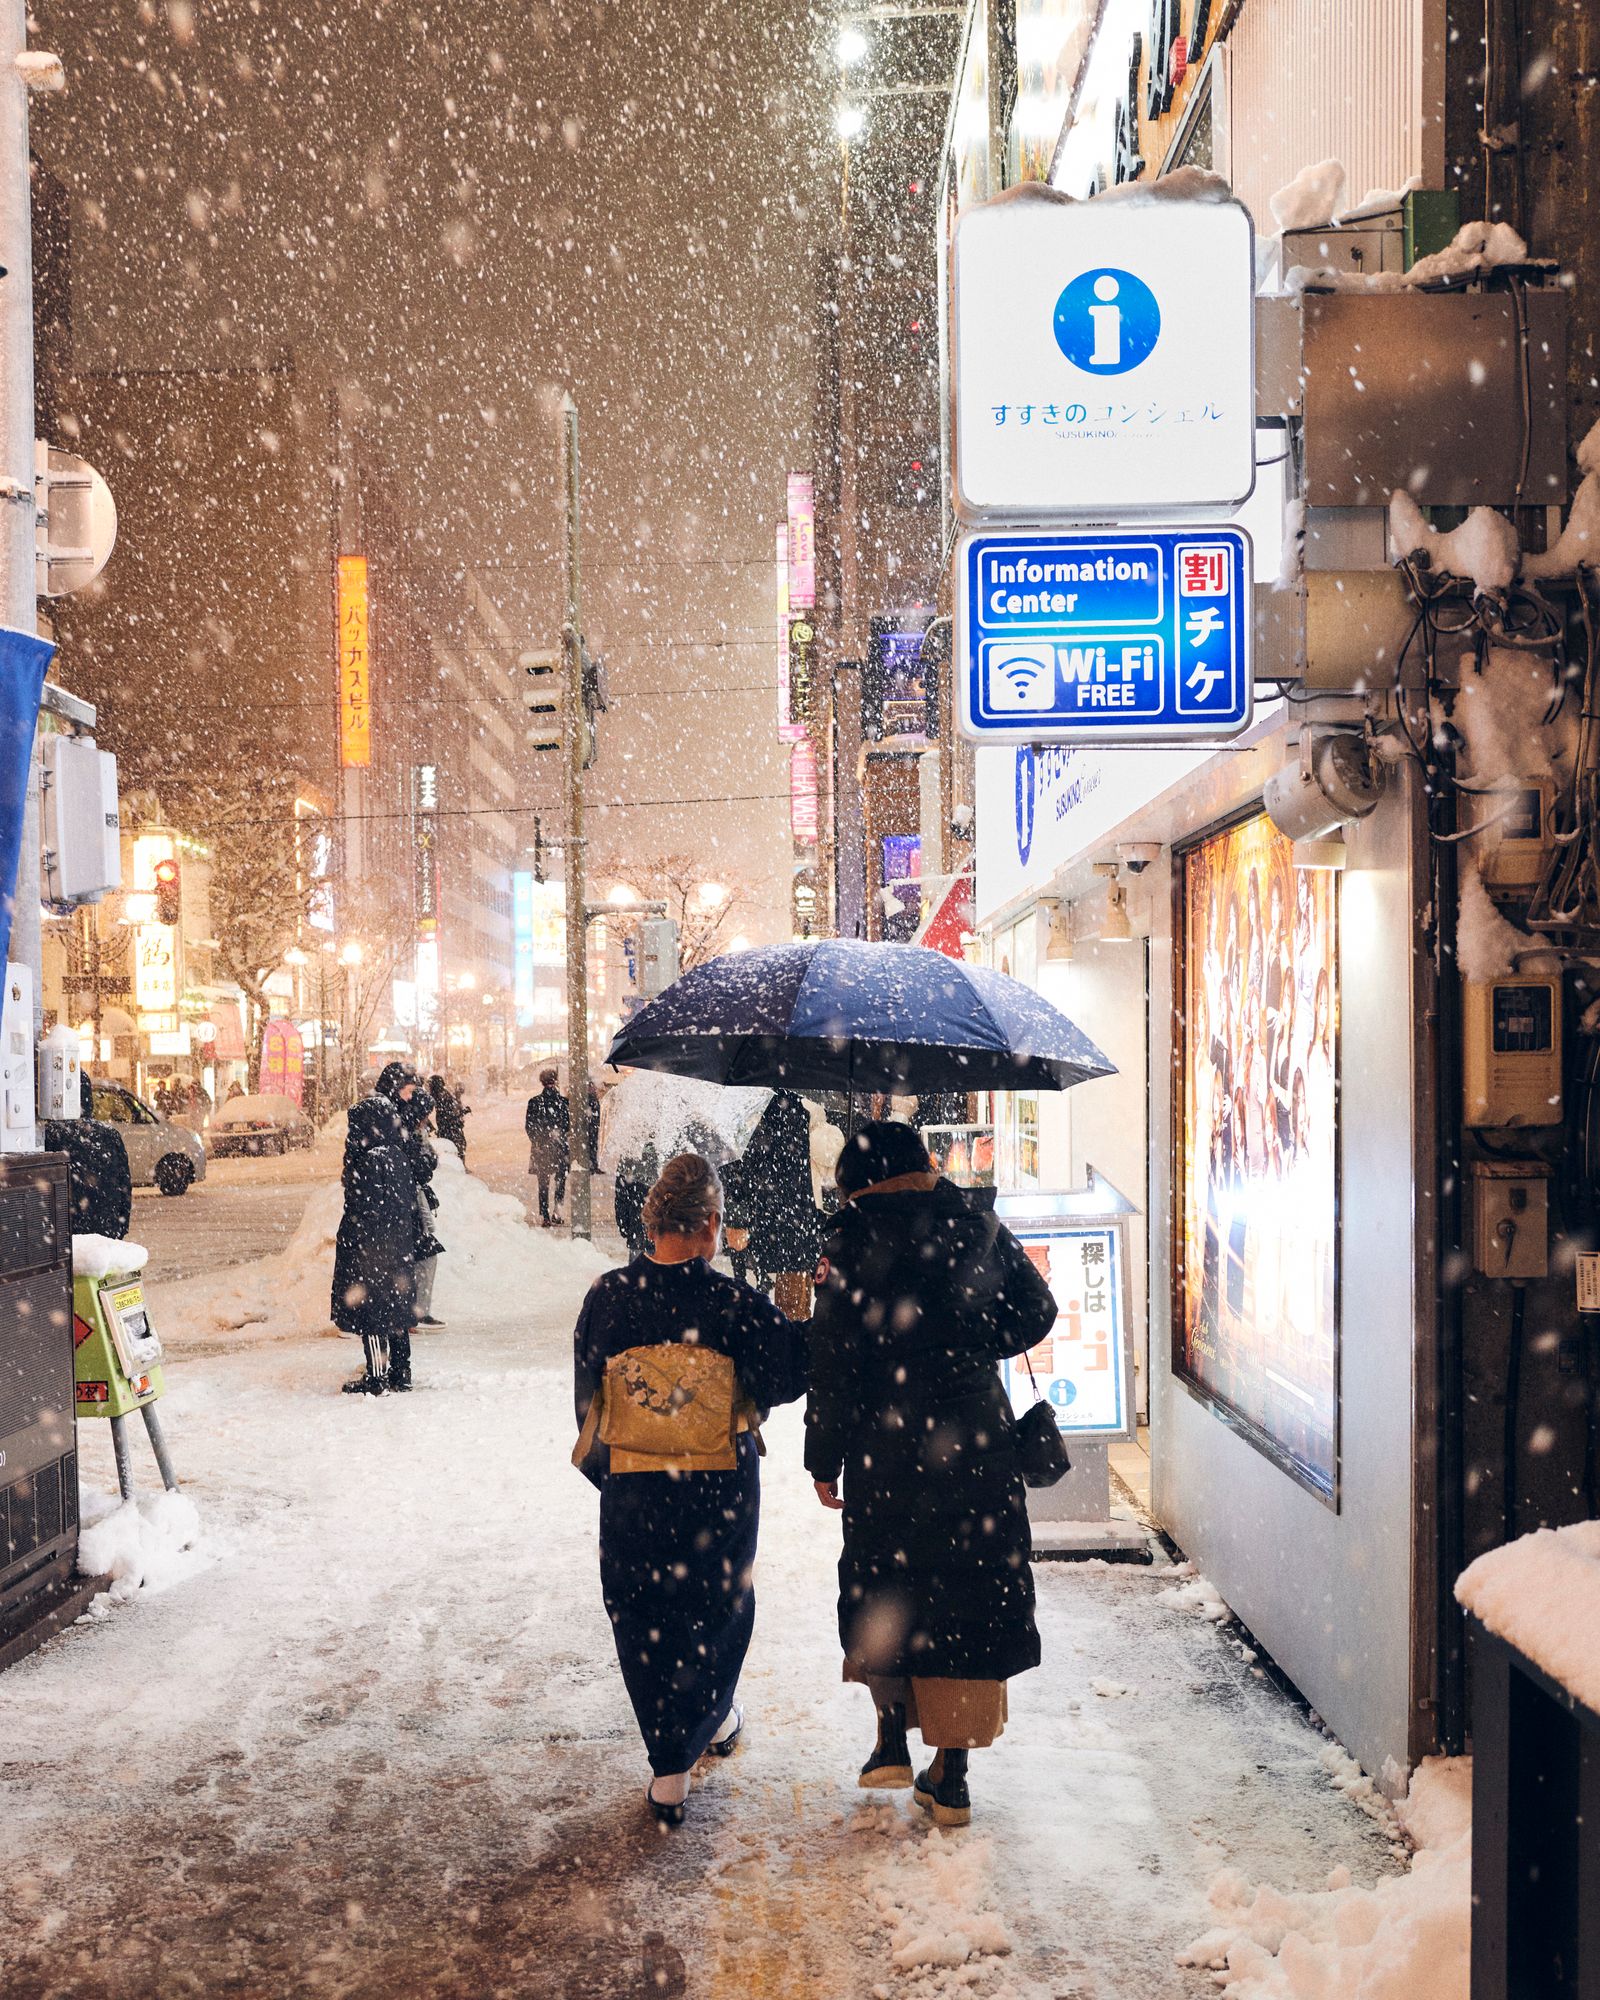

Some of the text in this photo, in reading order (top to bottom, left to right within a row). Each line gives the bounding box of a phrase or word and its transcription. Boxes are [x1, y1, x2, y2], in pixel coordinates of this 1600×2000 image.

[990, 557, 1148, 583] Information
[990, 590, 1078, 614] Center
[1184, 553, 1225, 702] 割チケ
[344, 605, 365, 730] バッカスビル
[1057, 645, 1154, 684] Wi-Fi
[1077, 684, 1136, 707] FREE
[1081, 1242, 1106, 1313] 探しは
